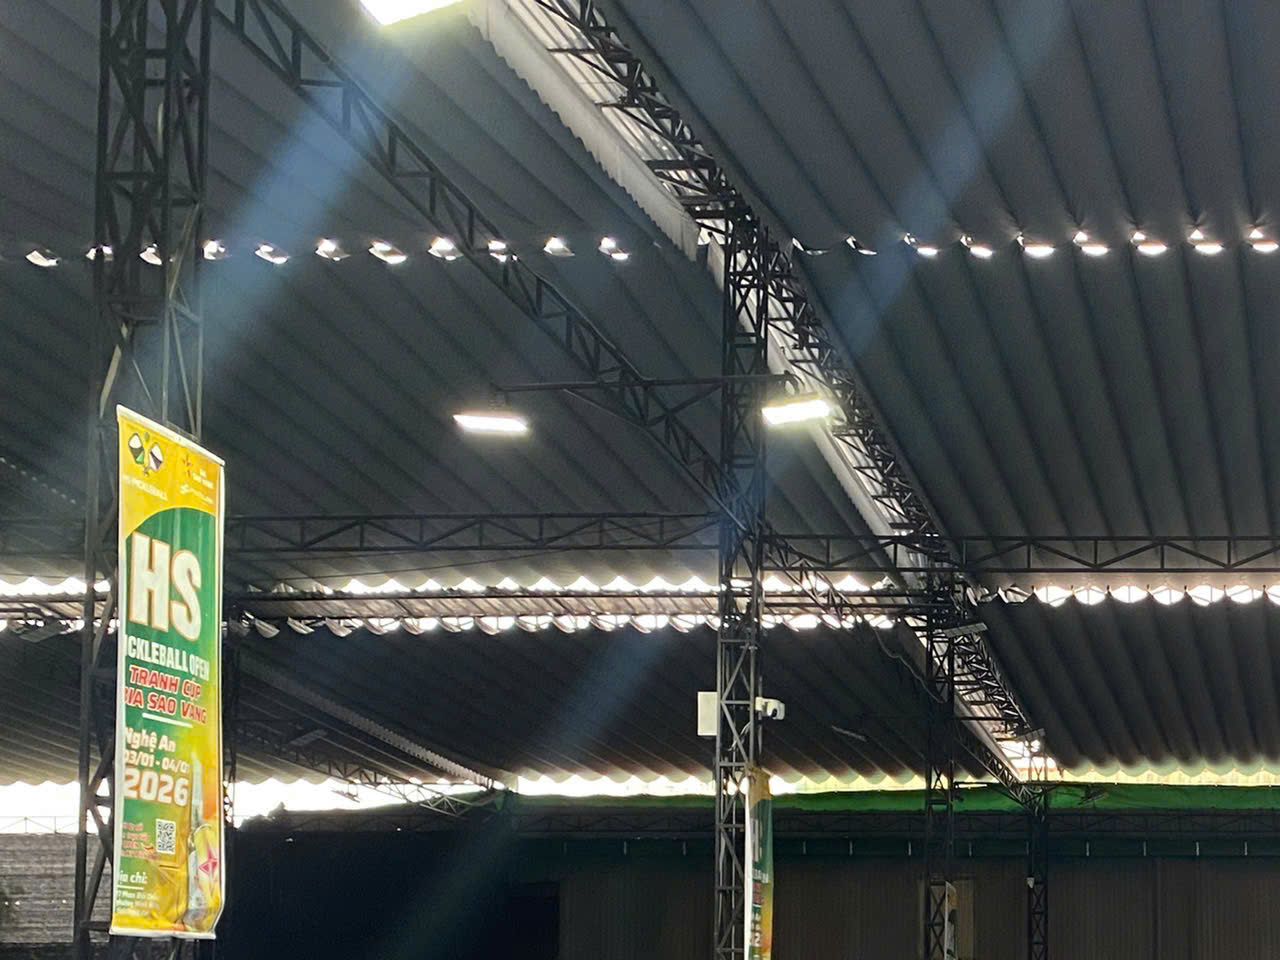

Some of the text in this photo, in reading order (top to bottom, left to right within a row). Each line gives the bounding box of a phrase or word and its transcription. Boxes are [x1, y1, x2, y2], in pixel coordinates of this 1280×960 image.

[129, 530, 202, 642] HS
[124, 634, 188, 673] ICKLEBALL
[129, 664, 180, 694] TRANH
[147, 691, 176, 716] SAO
[158, 735, 177, 752] An
[124, 766, 189, 807] 2026
